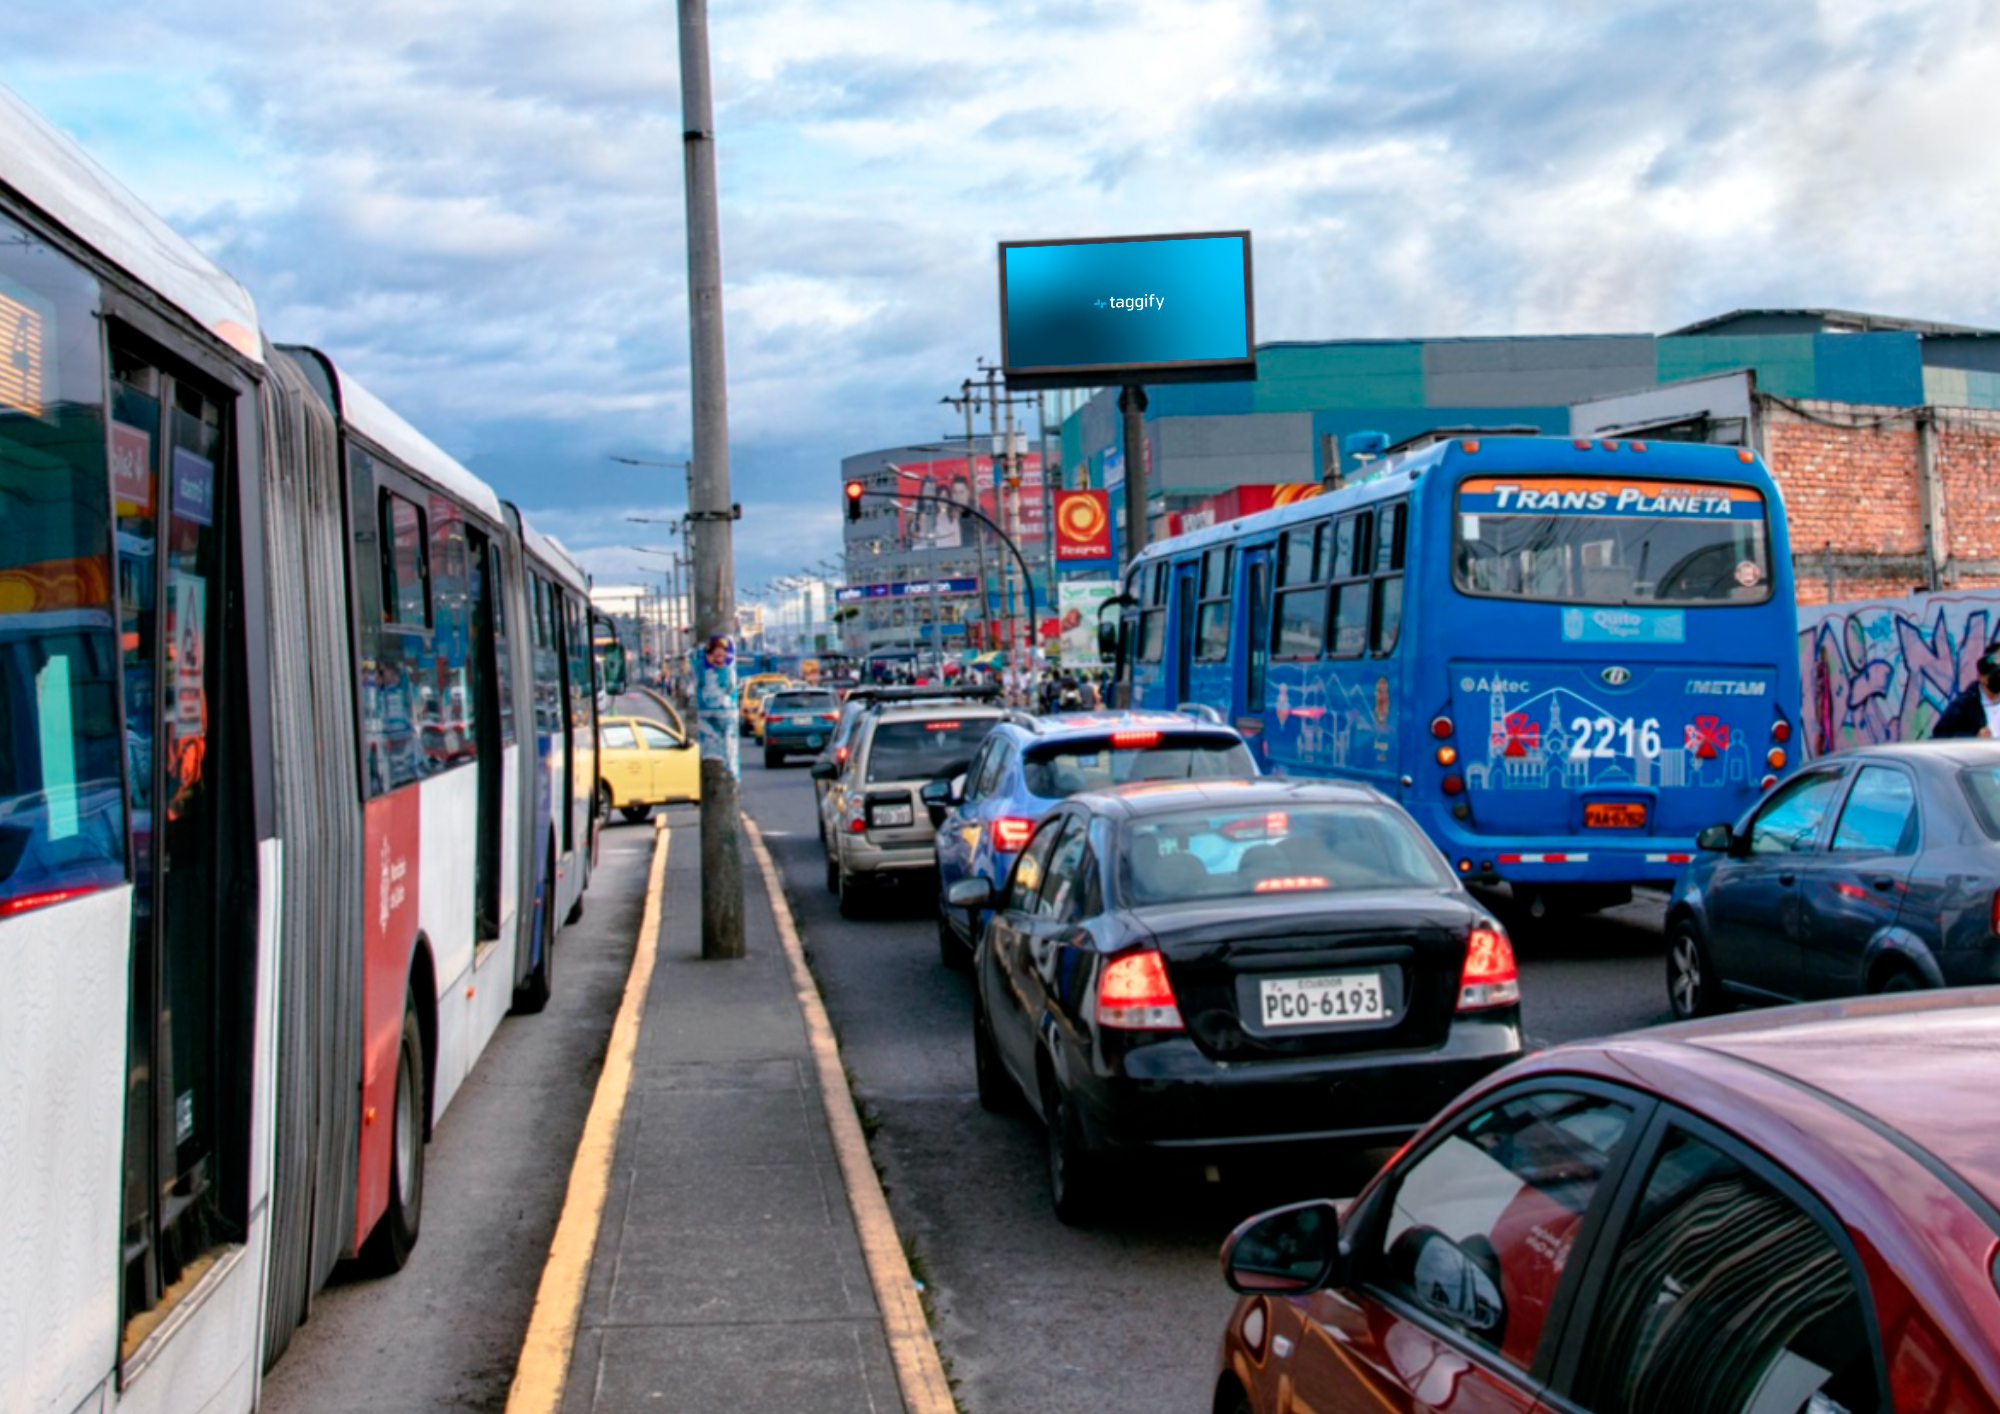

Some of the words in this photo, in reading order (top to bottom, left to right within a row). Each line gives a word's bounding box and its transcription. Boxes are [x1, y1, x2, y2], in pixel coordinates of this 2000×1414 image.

[1109, 294, 1165, 311] taggify
[1492, 484, 1608, 510] TRANS
[1616, 487, 1732, 514] PLANETA
[1592, 609, 1641, 629] Quito
[1570, 716, 1662, 760] 2216
[1297, 977, 1343, 990] ECUADOR
